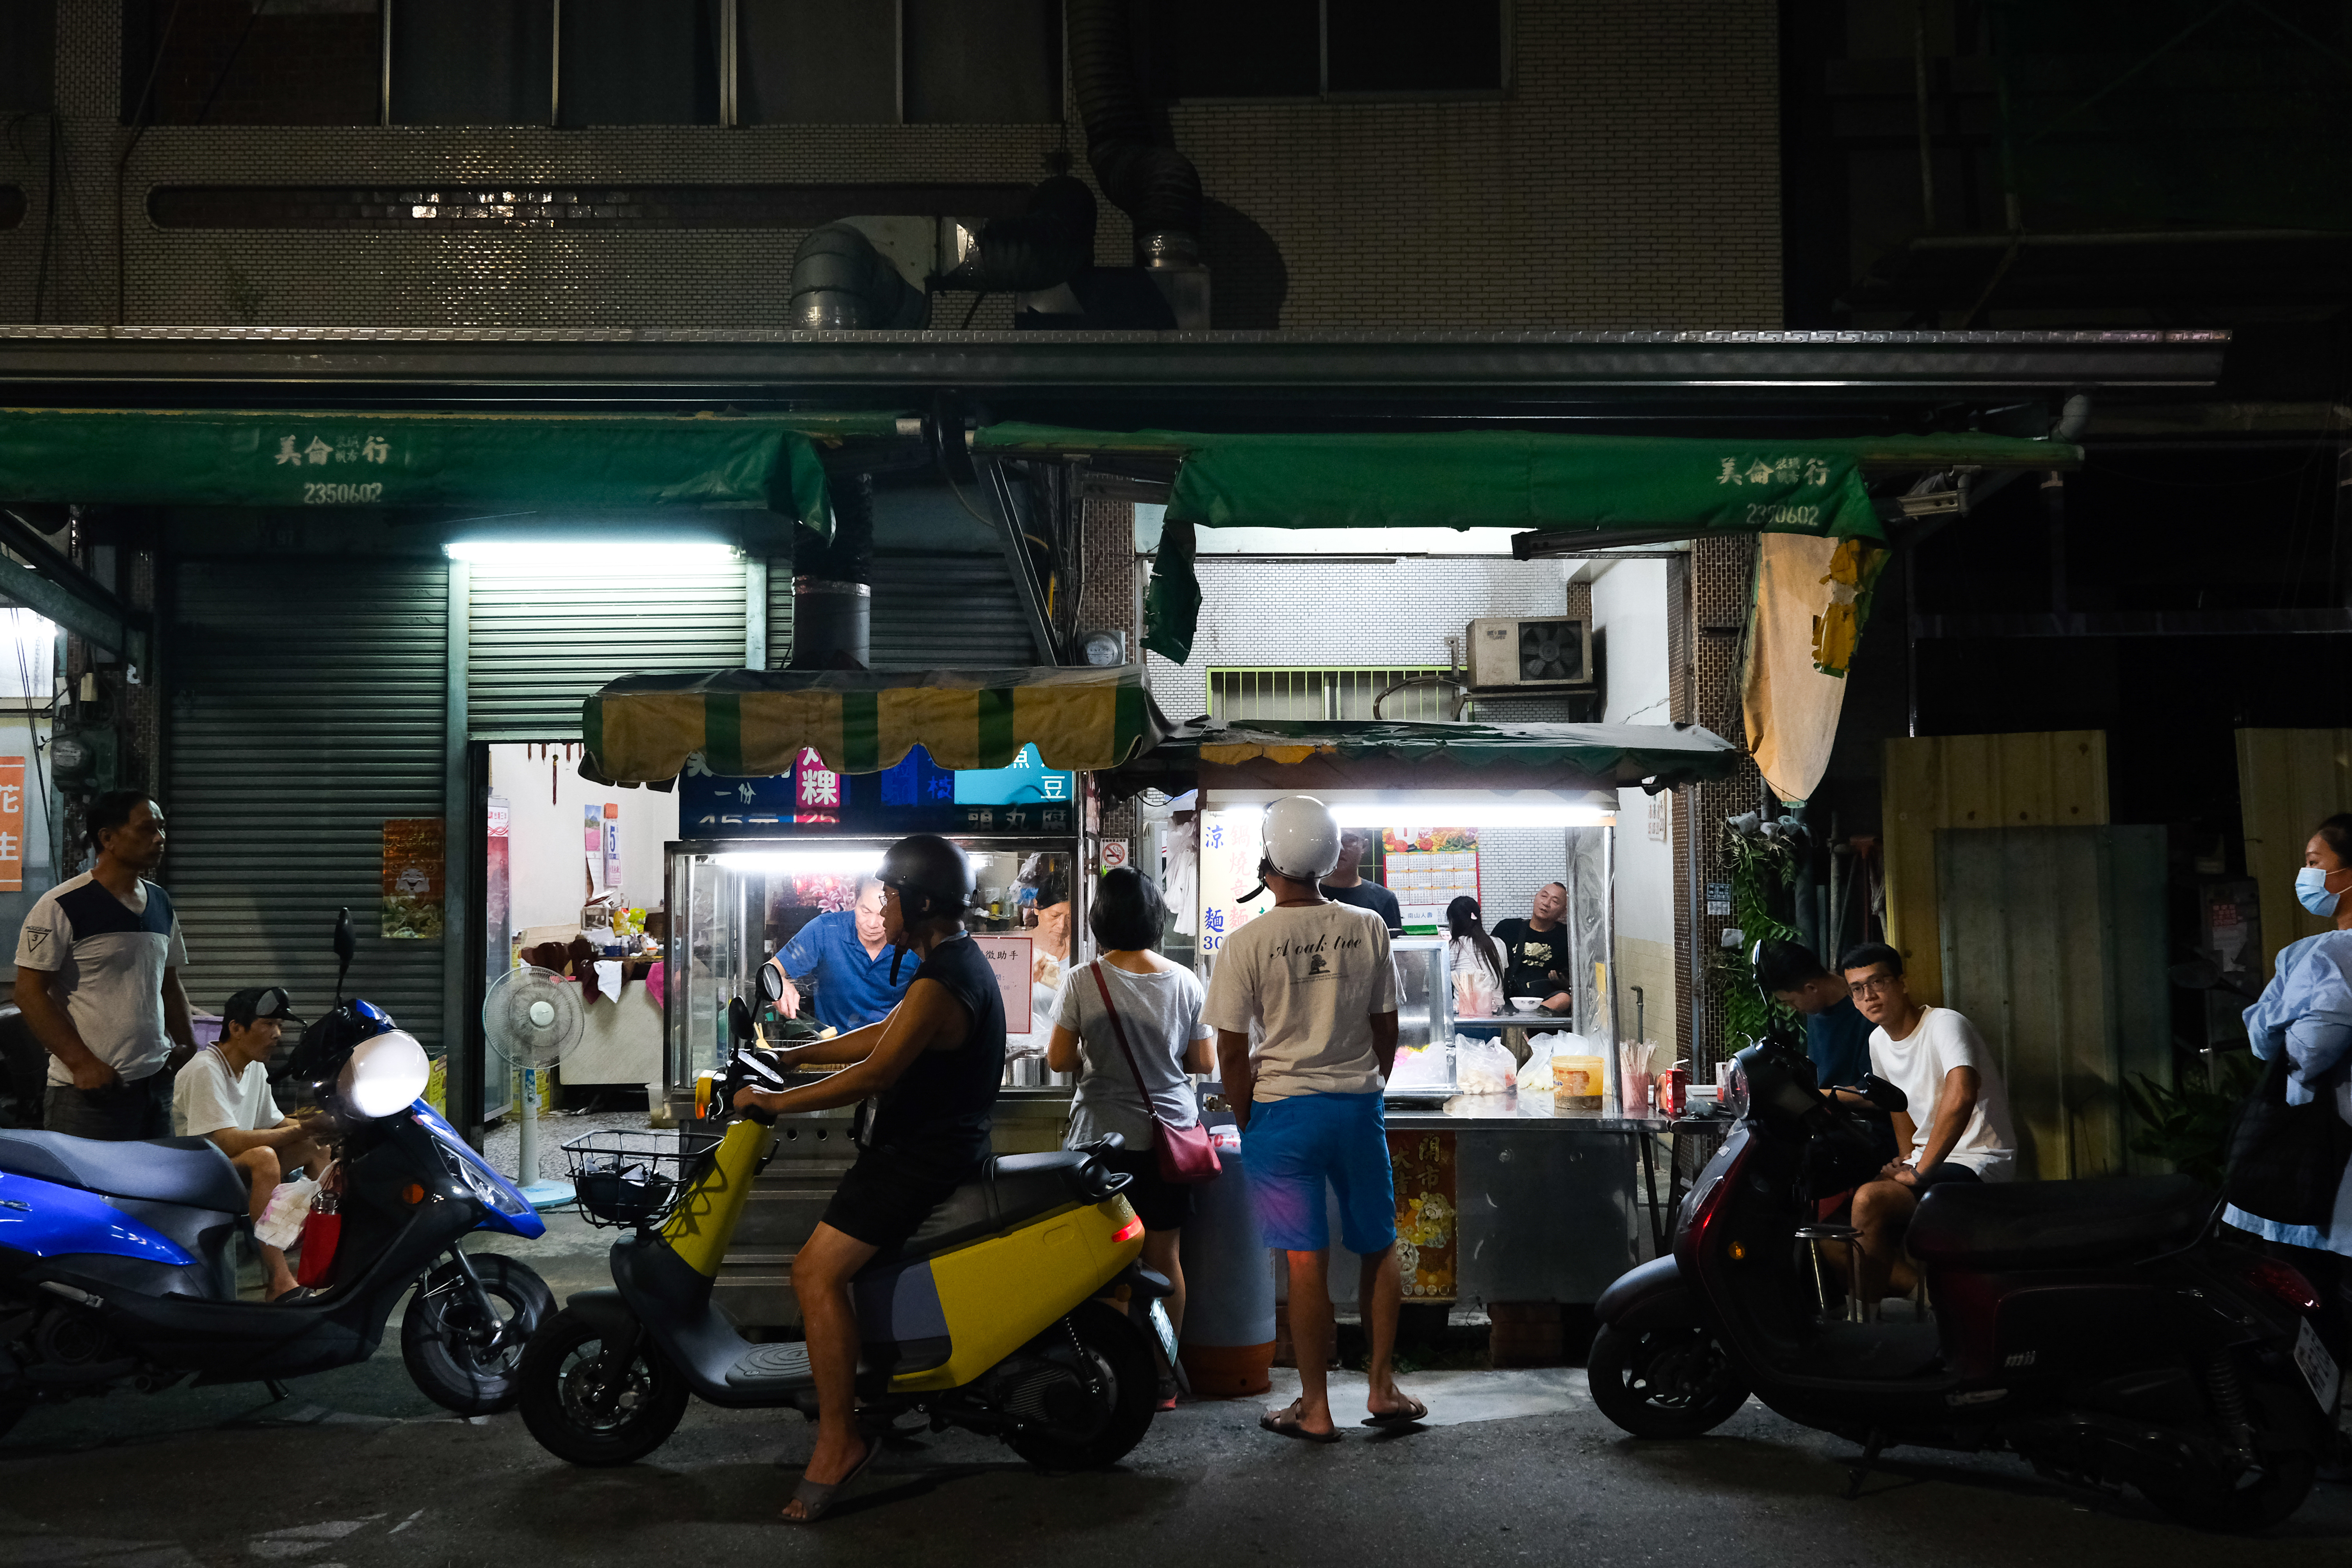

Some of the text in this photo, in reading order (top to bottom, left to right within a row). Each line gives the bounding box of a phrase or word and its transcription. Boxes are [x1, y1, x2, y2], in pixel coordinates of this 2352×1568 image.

[304, 482, 383, 505] 2350602
[610, 826, 616, 853] 5
[981, 950, 1019, 960] 徵助手
[1270, 934, 1361, 959] A oak tree
[1416, 1136, 1440, 1191] 開市
